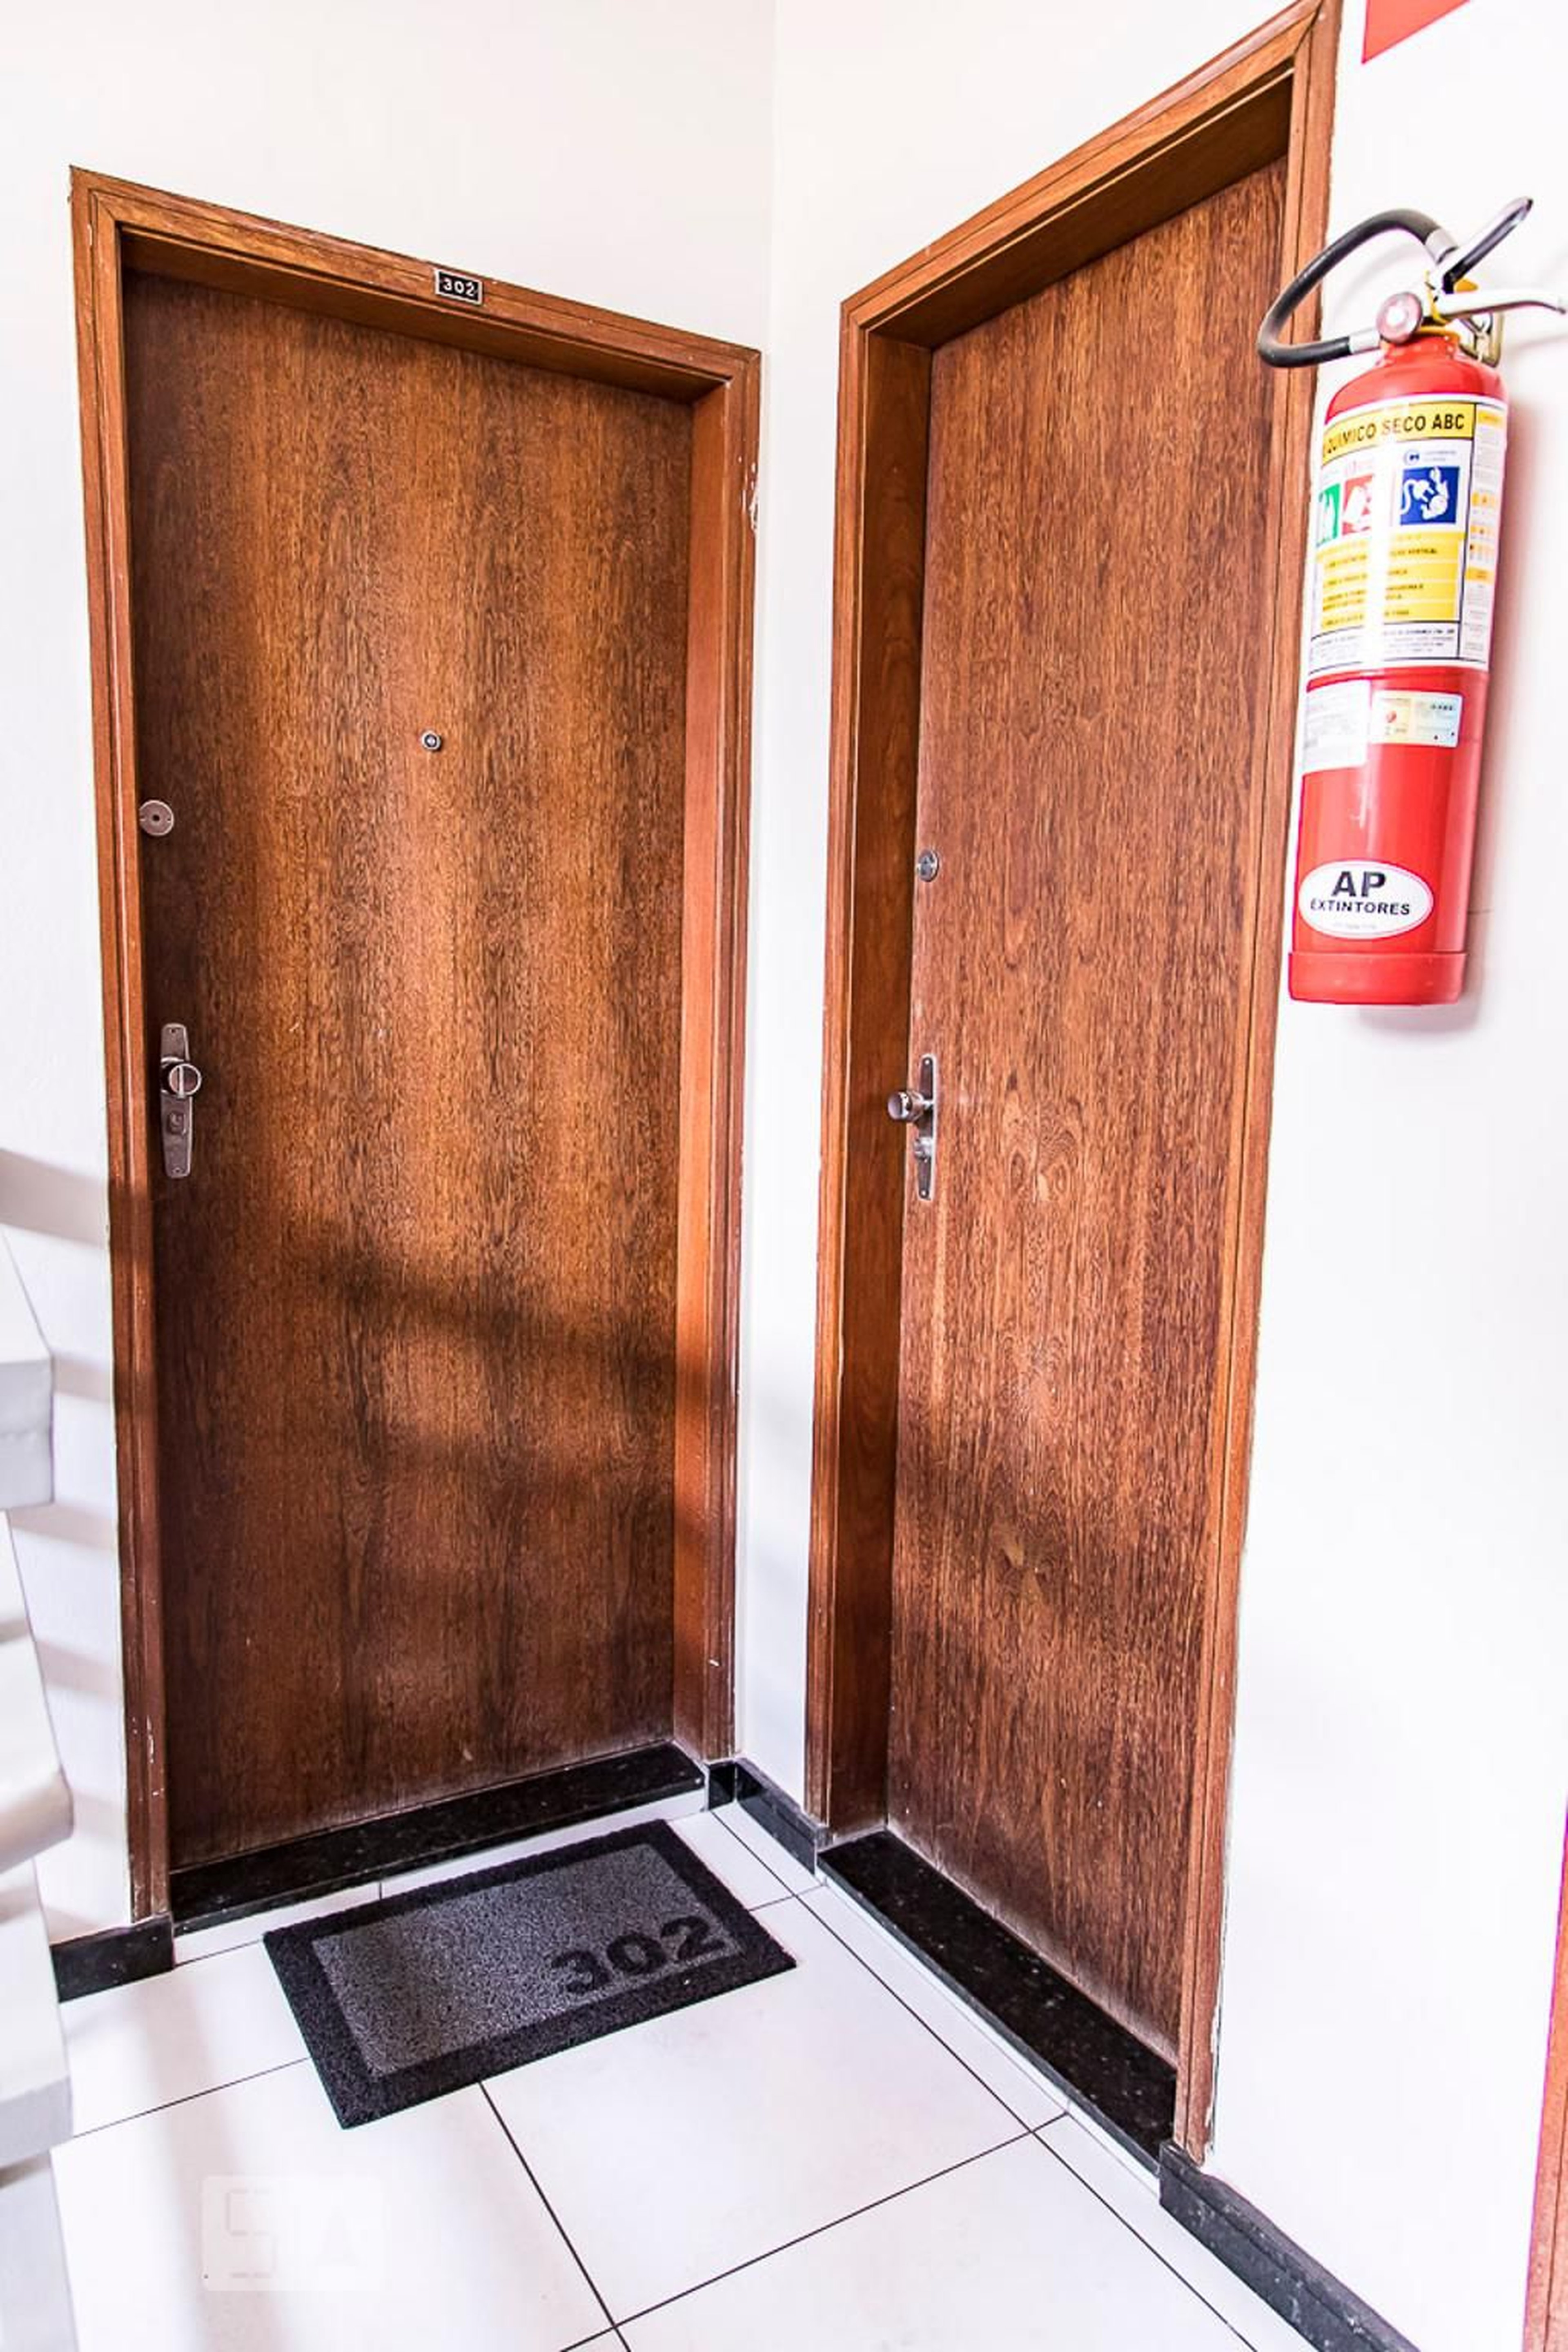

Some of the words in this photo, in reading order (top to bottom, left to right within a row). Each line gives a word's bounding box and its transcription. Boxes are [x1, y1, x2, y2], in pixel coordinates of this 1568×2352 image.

[443, 278, 474, 296] 302
[1381, 416, 1426, 434] SECO
[1431, 413, 1465, 430] ABC
[1331, 871, 1387, 897] AP
[1310, 898, 1410, 915] EXTINTORES
[551, 1916, 726, 1994] 302
